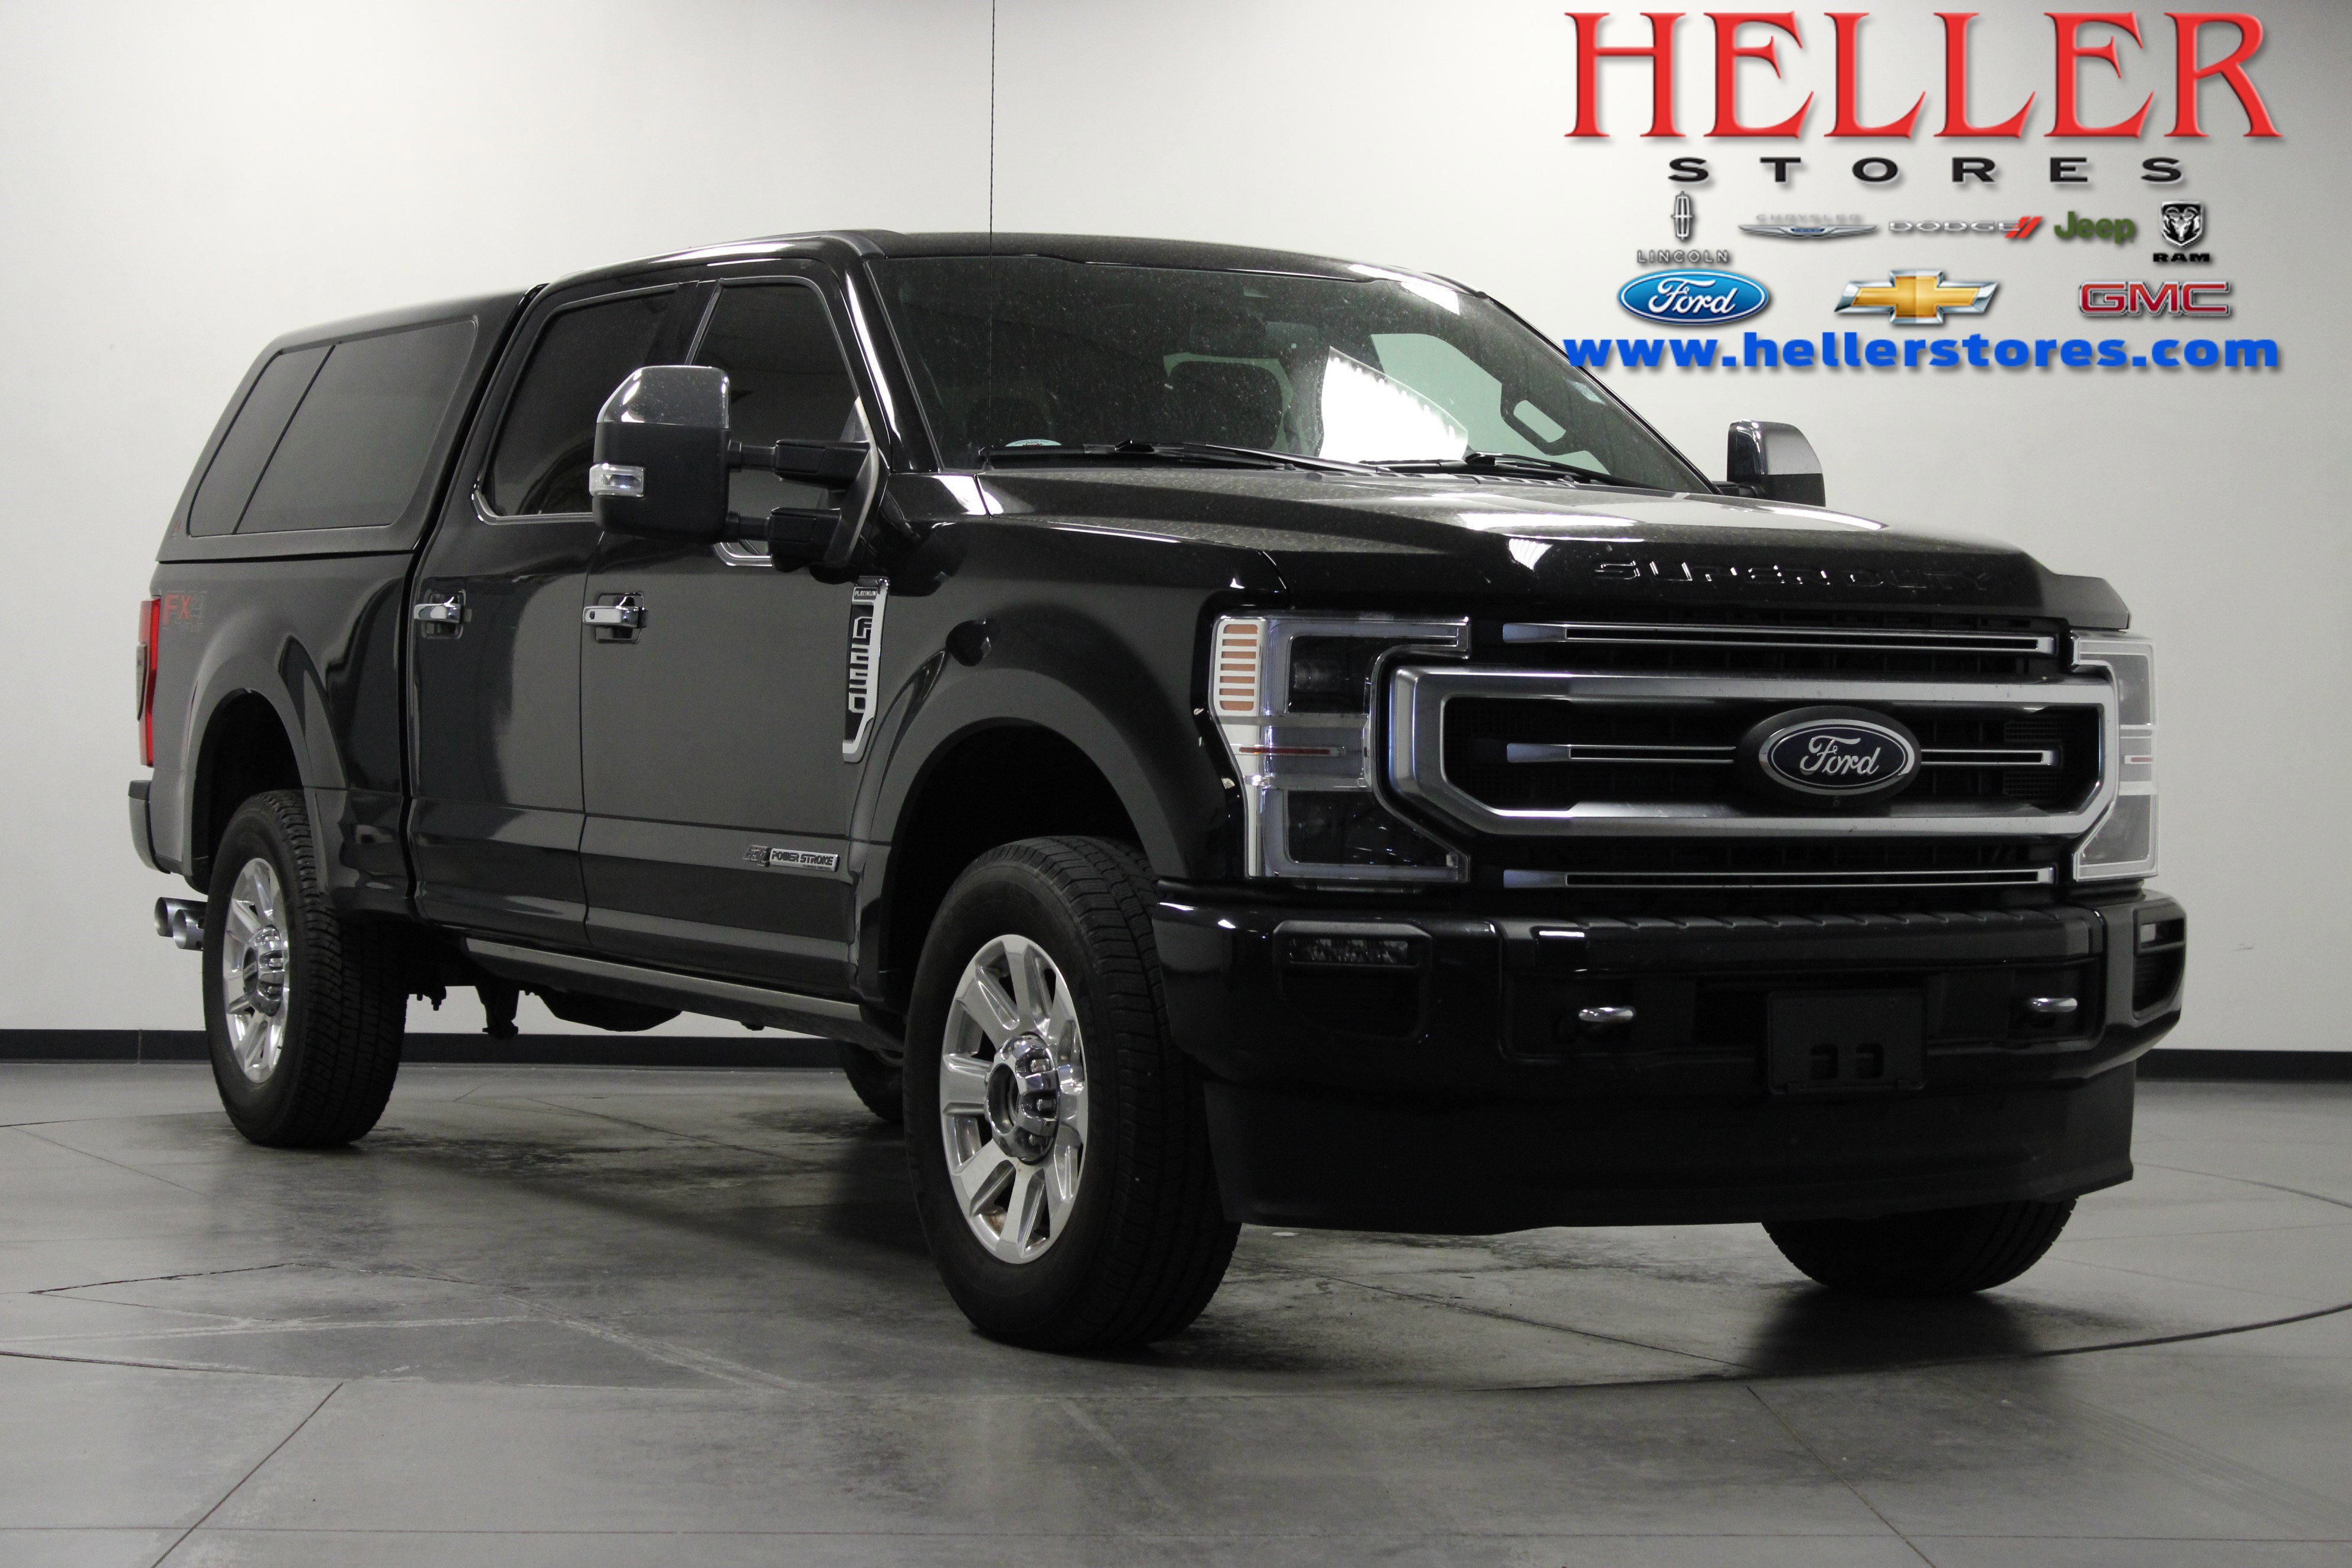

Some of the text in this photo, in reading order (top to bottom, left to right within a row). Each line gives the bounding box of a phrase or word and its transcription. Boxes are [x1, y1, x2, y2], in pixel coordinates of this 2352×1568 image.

[1800, 735, 1881, 776] Ford
[771, 850, 799, 862] POWER
[800, 854, 834, 866] STROKE
